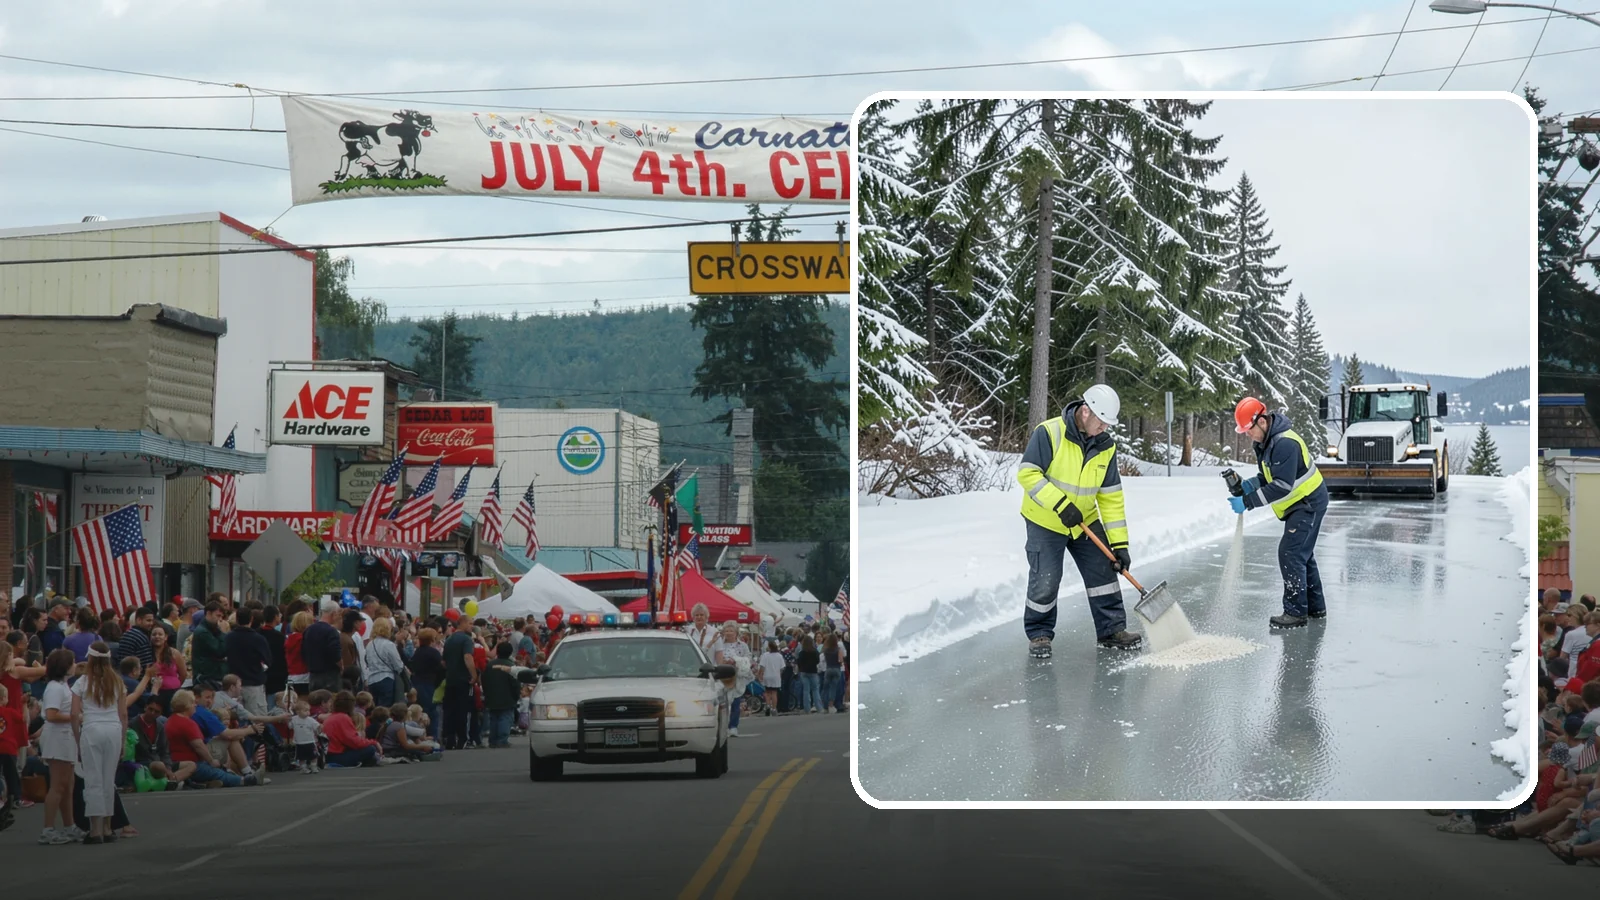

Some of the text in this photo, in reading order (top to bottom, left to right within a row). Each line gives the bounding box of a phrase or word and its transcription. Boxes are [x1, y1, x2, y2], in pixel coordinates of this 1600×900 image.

[481, 140, 605, 192] JULY
[632, 150, 746, 198] 4th.
[697, 254, 850, 280] CROSSWA
[283, 380, 373, 420] ACE
[283, 421, 370, 436] Hardware
[416, 428, 478, 447] Coca-Cola
[353, 467, 384, 480] Simpl
[95, 485, 124, 495] Vincent
[126, 486, 136, 495] de
[137, 486, 155, 495] Paul
[688, 526, 741, 535] CRNATION
[699, 535, 731, 543] GLASS
